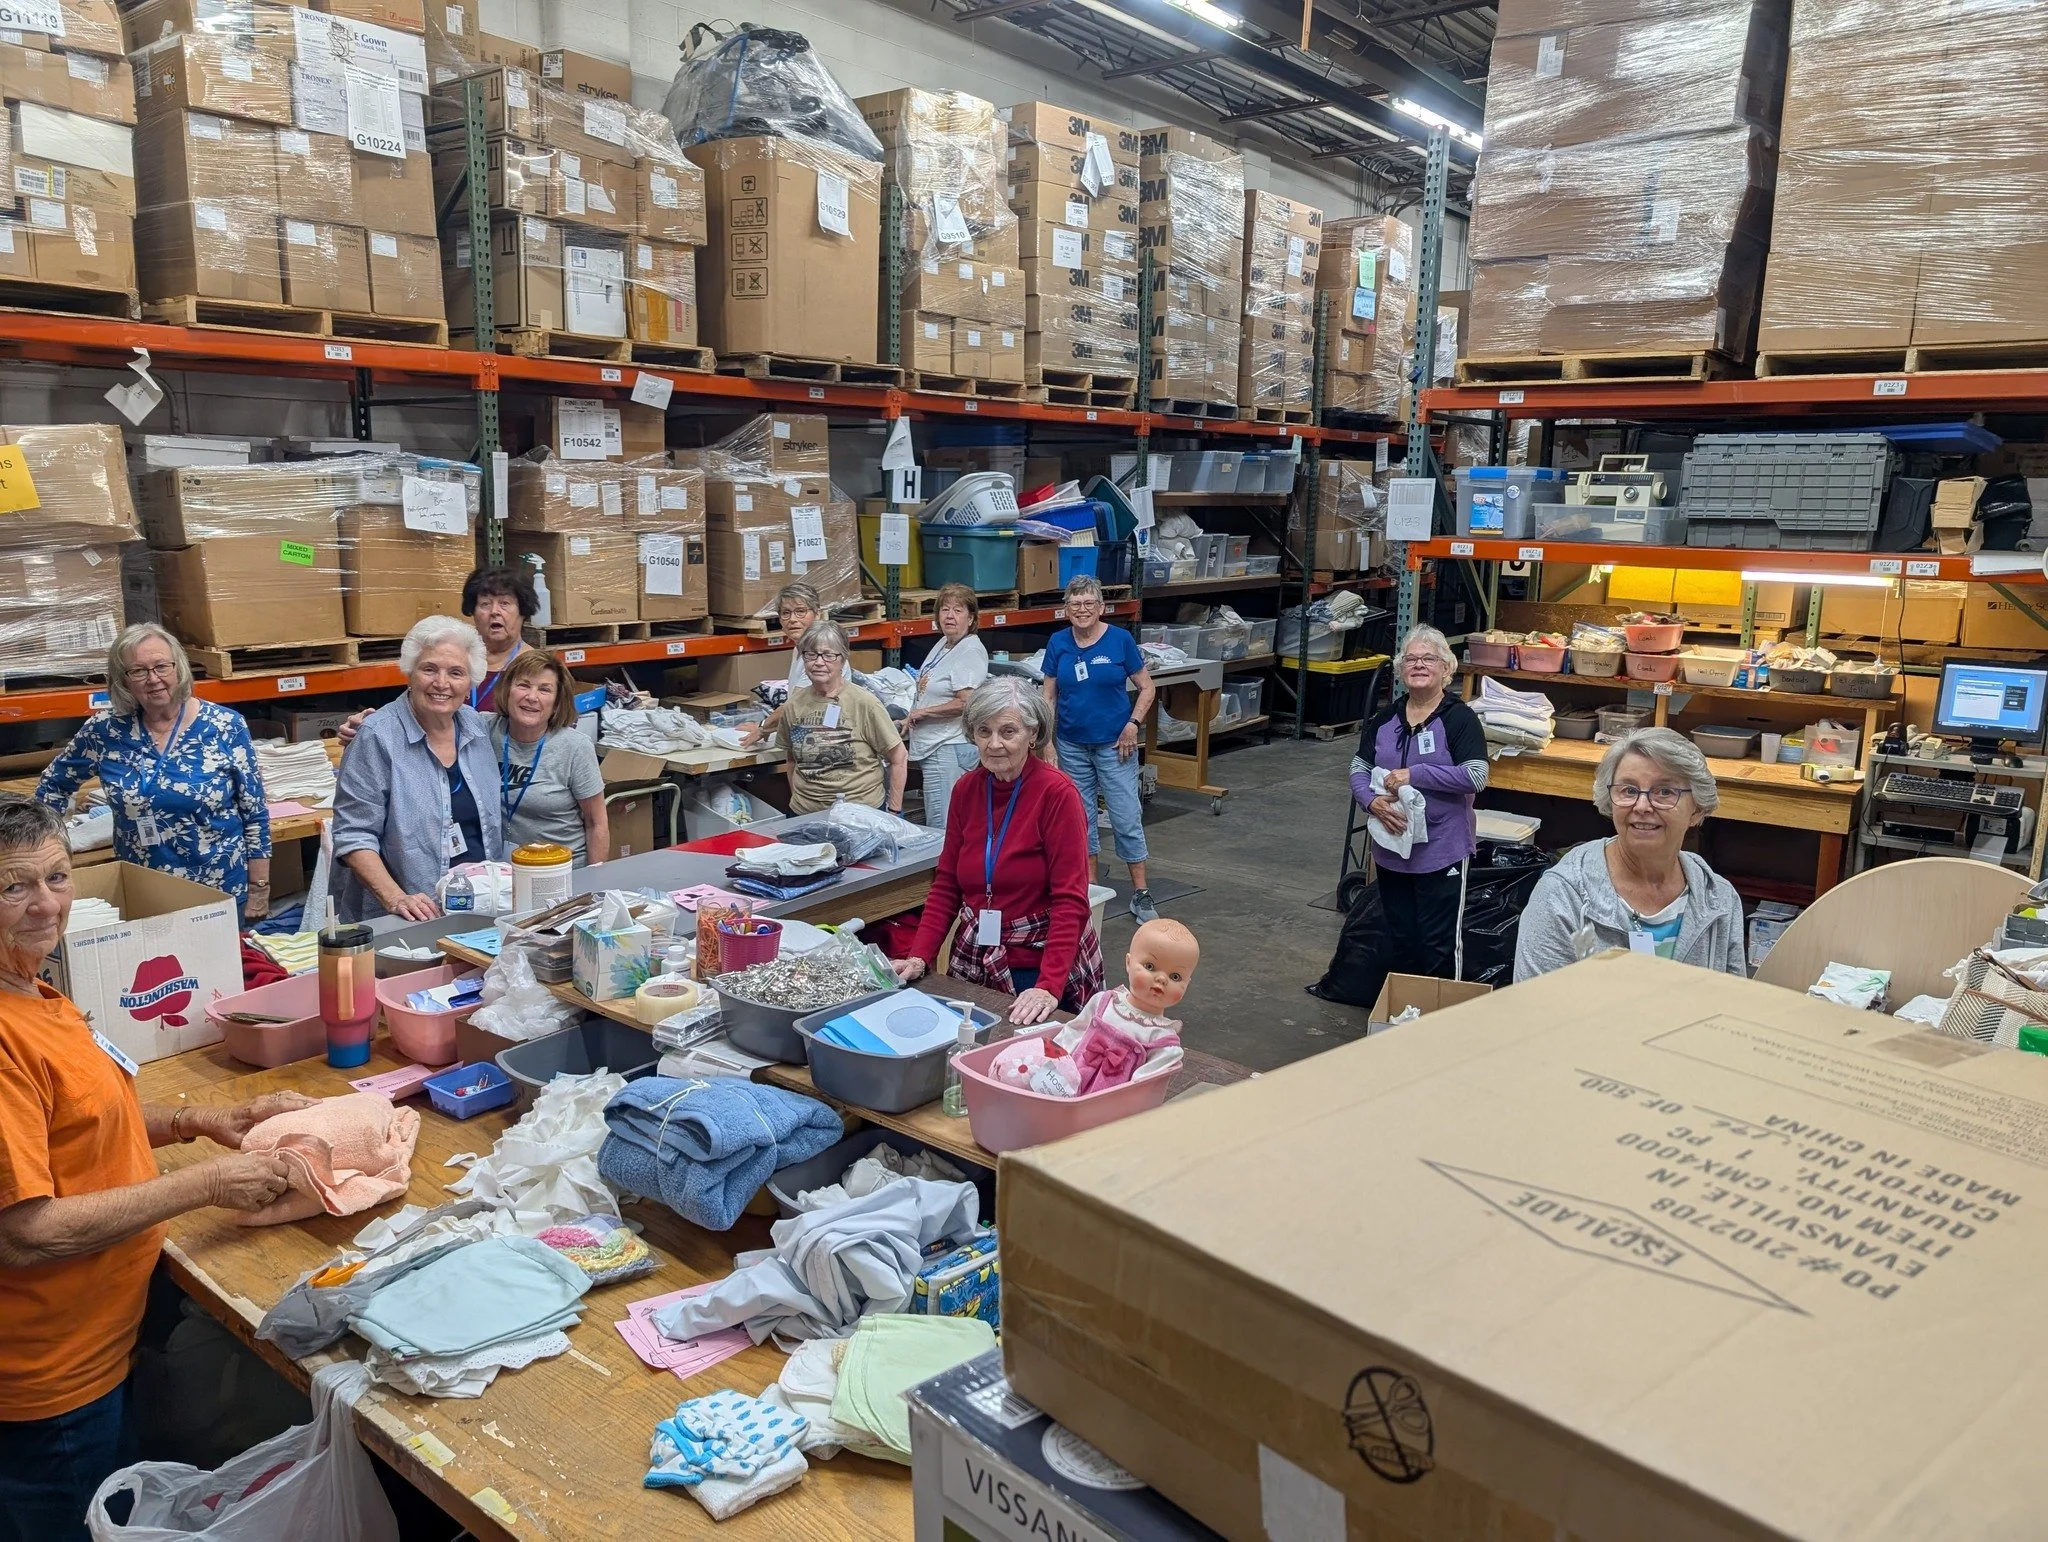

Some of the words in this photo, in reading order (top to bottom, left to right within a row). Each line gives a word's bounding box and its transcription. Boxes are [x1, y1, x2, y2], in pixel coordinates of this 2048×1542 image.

[361, 33, 387, 48] Gown
[1068, 115, 1090, 137] 3M
[357, 133, 402, 153] G10224
[1140, 132, 1168, 157] 3M
[1139, 179, 1167, 203] 3M
[820, 201, 846, 219] G10529
[1118, 204, 1138, 226] 3M
[1309, 211, 1321, 229] 3M
[941, 231, 966, 240] G9510
[1138, 225, 1167, 249] 3M
[1069, 268, 1090, 289] 3M
[563, 437, 602, 448] F10542
[783, 440, 818, 452] stryker
[903, 470, 916, 499] H
[286, 543, 308, 553] MIXED
[798, 537, 822, 547] F10627
[282, 549, 311, 561] CARTON
[649, 555, 680, 567] G10540
[590, 607, 627, 616] CardinalHealth
[1637, 633, 1657, 642] Combs
[1636, 663, 1657, 673] Combs
[209, 909, 228, 920] PRODUCE
[72, 937, 96, 949] BUSHEL
[96, 932, 119, 944] VOLUME
[120, 930, 132, 940] ONE
[119, 976, 200, 1009] WASHINGTON
[1579, 1076, 1637, 1099] 500
[1639, 1098, 1684, 1115] OF
[1667, 1126, 1714, 1147] PC
[1764, 1114, 1866, 1153] CHINA
[1615, 1131, 1772, 1191] CMX4000
[1734, 1149, 1754, 1160] 1
[1870, 1150, 1912, 1169] IN
[1645, 1167, 1691, 1189] IN
[1915, 1164, 2022, 1207] MADE
[1853, 1166, 2000, 1223] CARTON
[1507, 1190, 1685, 1267] ESCALADE
[1856, 1216, 1954, 1259] ITEM
